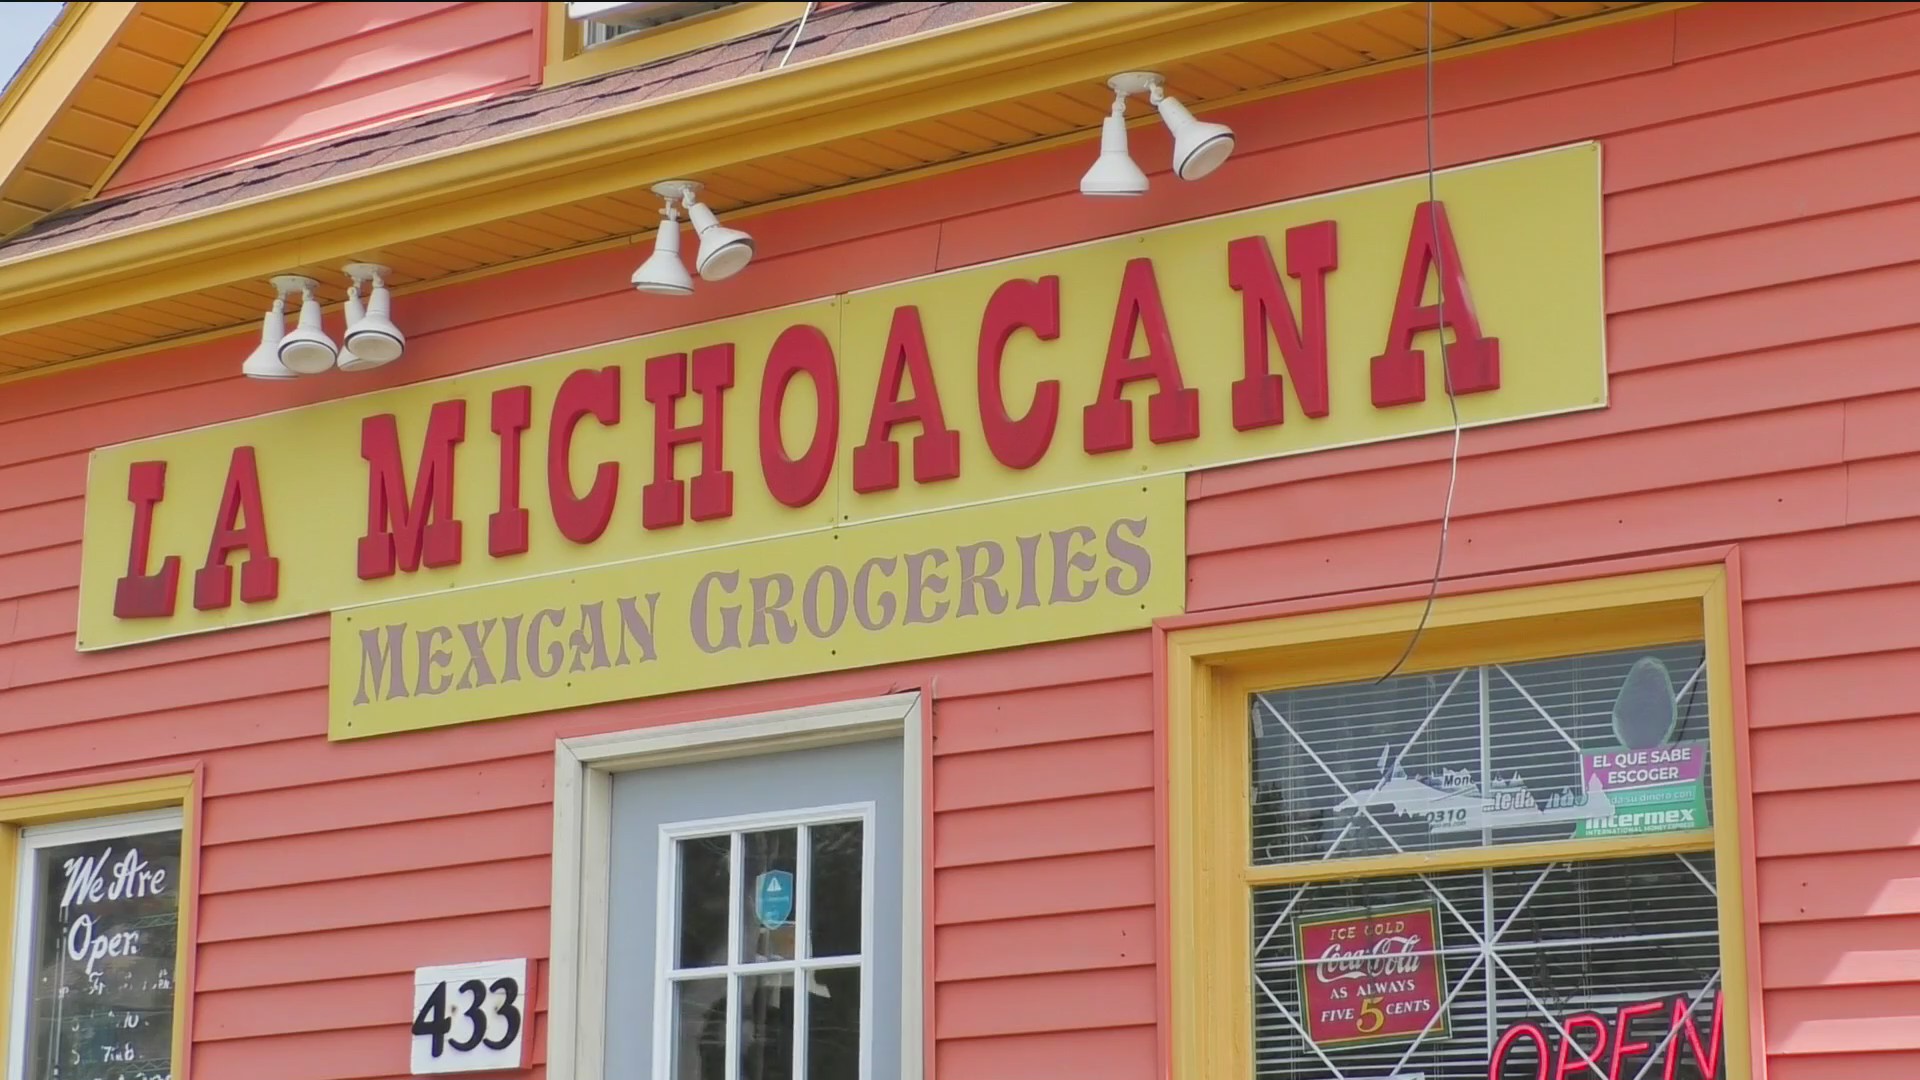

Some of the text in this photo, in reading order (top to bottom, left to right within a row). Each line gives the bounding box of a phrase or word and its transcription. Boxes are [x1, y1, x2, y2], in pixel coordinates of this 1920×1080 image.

[113, 201, 1500, 618] LA MICHOACANA
[353, 517, 1153, 706] MEXICAN GROCERIES
[1593, 747, 1692, 768] EL QUE SABE
[1608, 766, 1679, 784] ESCOGER
[61, 847, 166, 907] We Are
[1329, 926, 1357, 941] ICE
[1330, 979, 1416, 1000] AS ALWAYS
[411, 976, 521, 1058] 433
[1320, 996, 1431, 1034] FIVE 5 CENTS
[1488, 991, 1724, 1080] OPEN
